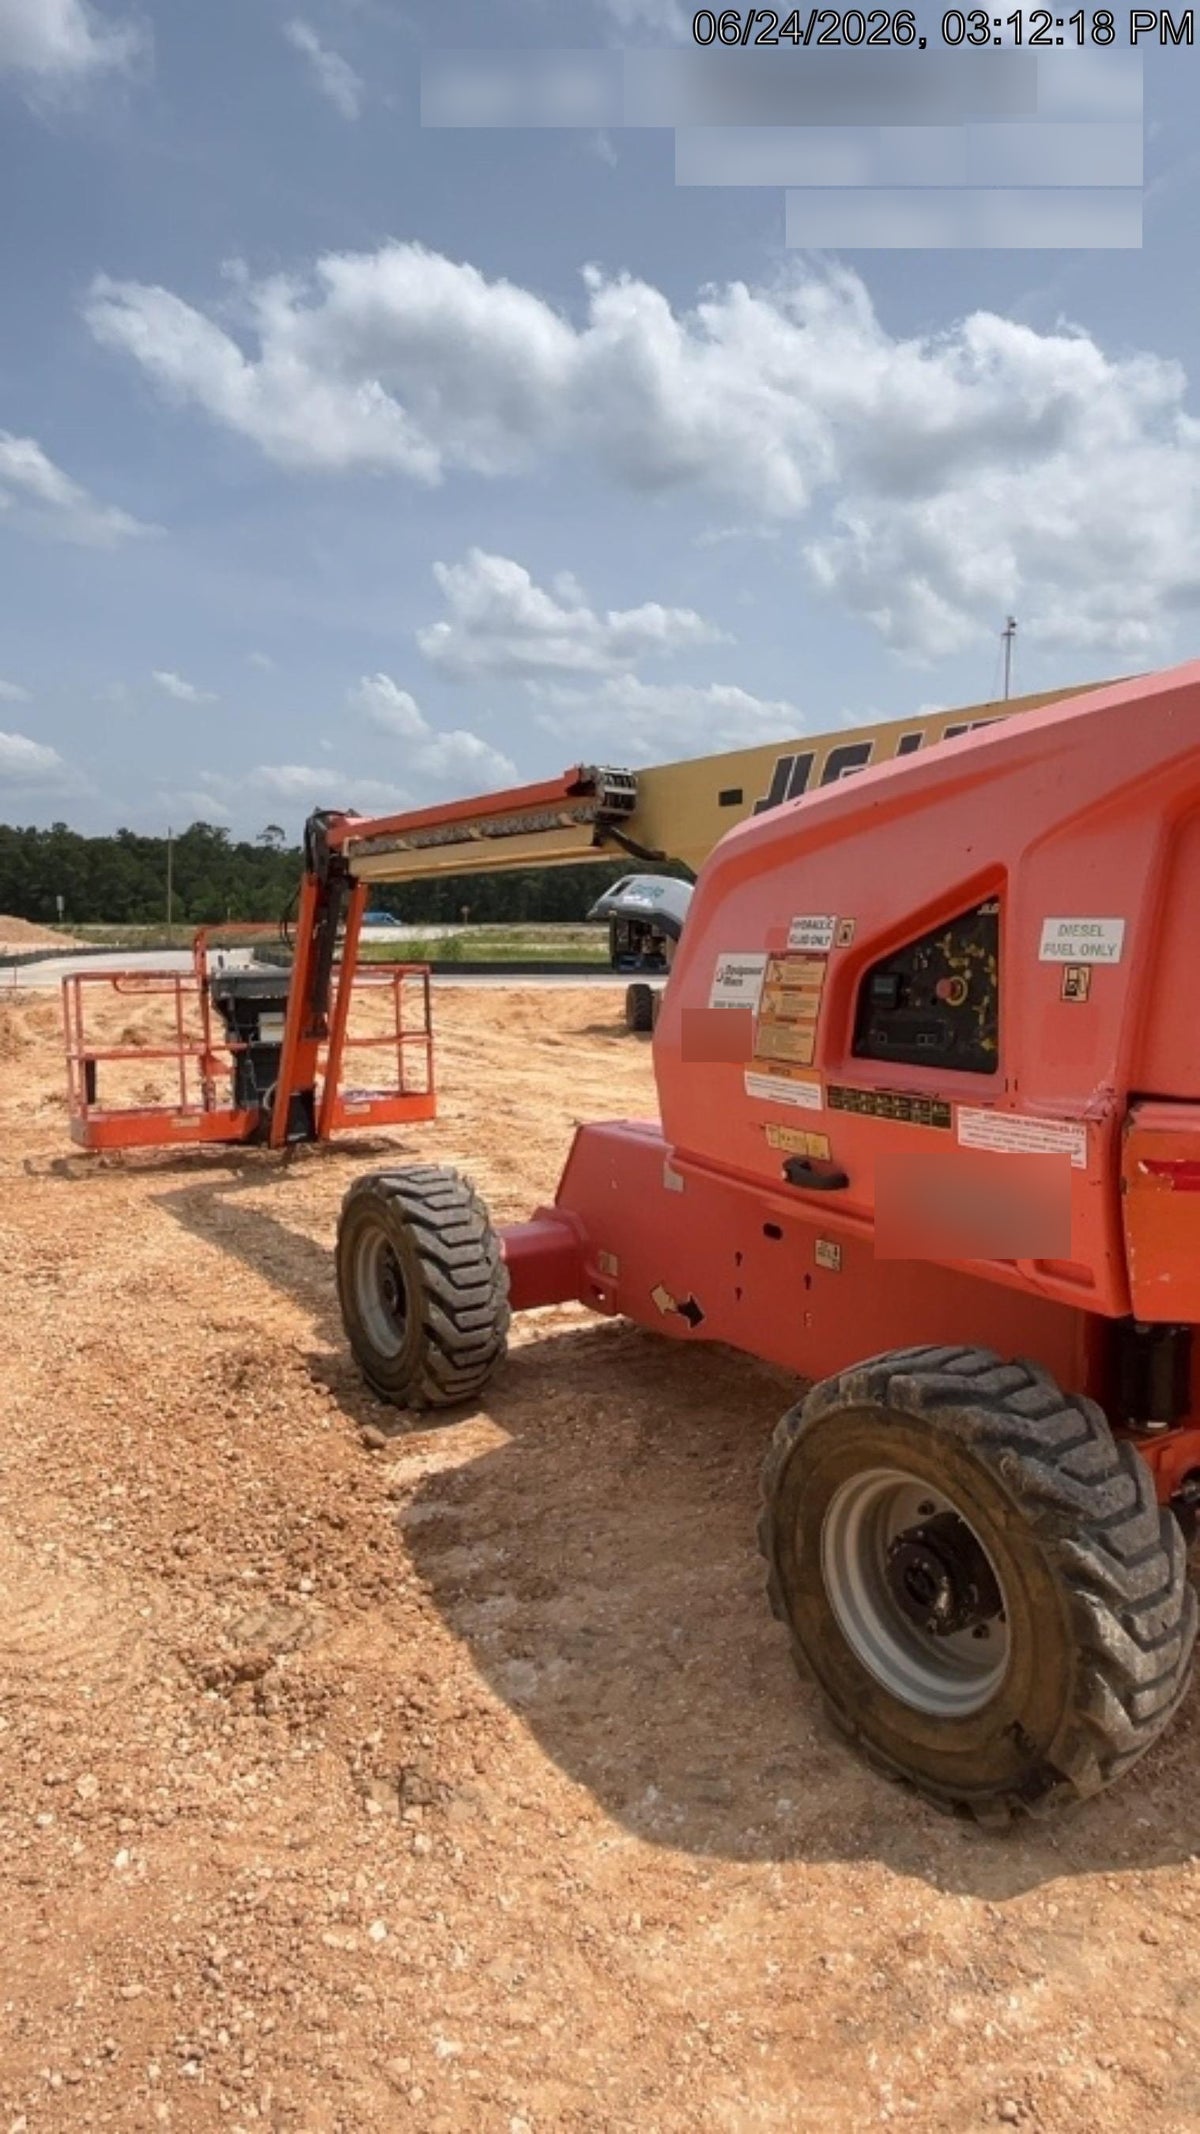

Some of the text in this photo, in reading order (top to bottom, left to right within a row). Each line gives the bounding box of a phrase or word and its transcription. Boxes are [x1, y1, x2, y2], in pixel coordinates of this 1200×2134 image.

[1057, 924, 1105, 938] DIESEL
[811, 934, 831, 947] ONLY
[1043, 943, 1118, 957] FUEL ONLY
